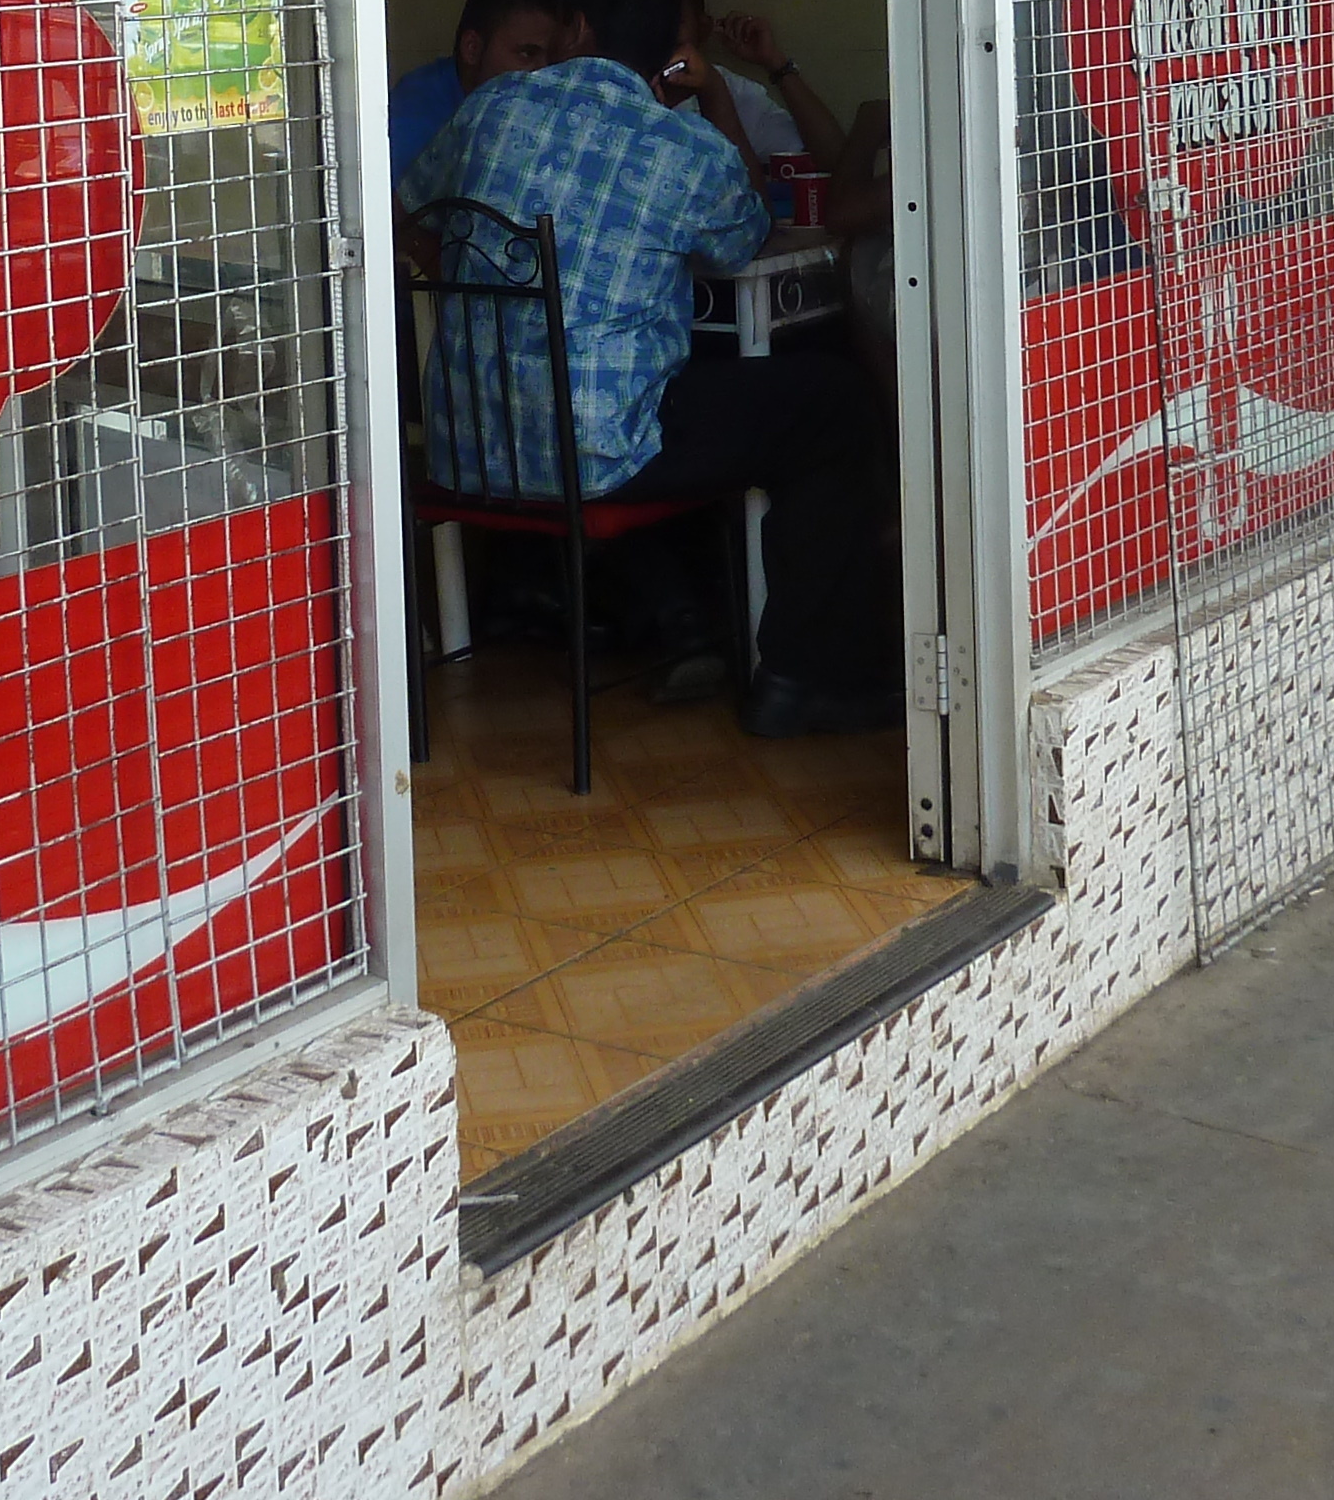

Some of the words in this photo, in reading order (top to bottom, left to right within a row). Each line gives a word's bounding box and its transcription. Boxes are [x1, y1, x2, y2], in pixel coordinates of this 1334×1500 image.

[148, 108, 179, 128] enjy
[181, 107, 193, 123] to
[215, 101, 236, 119] last
